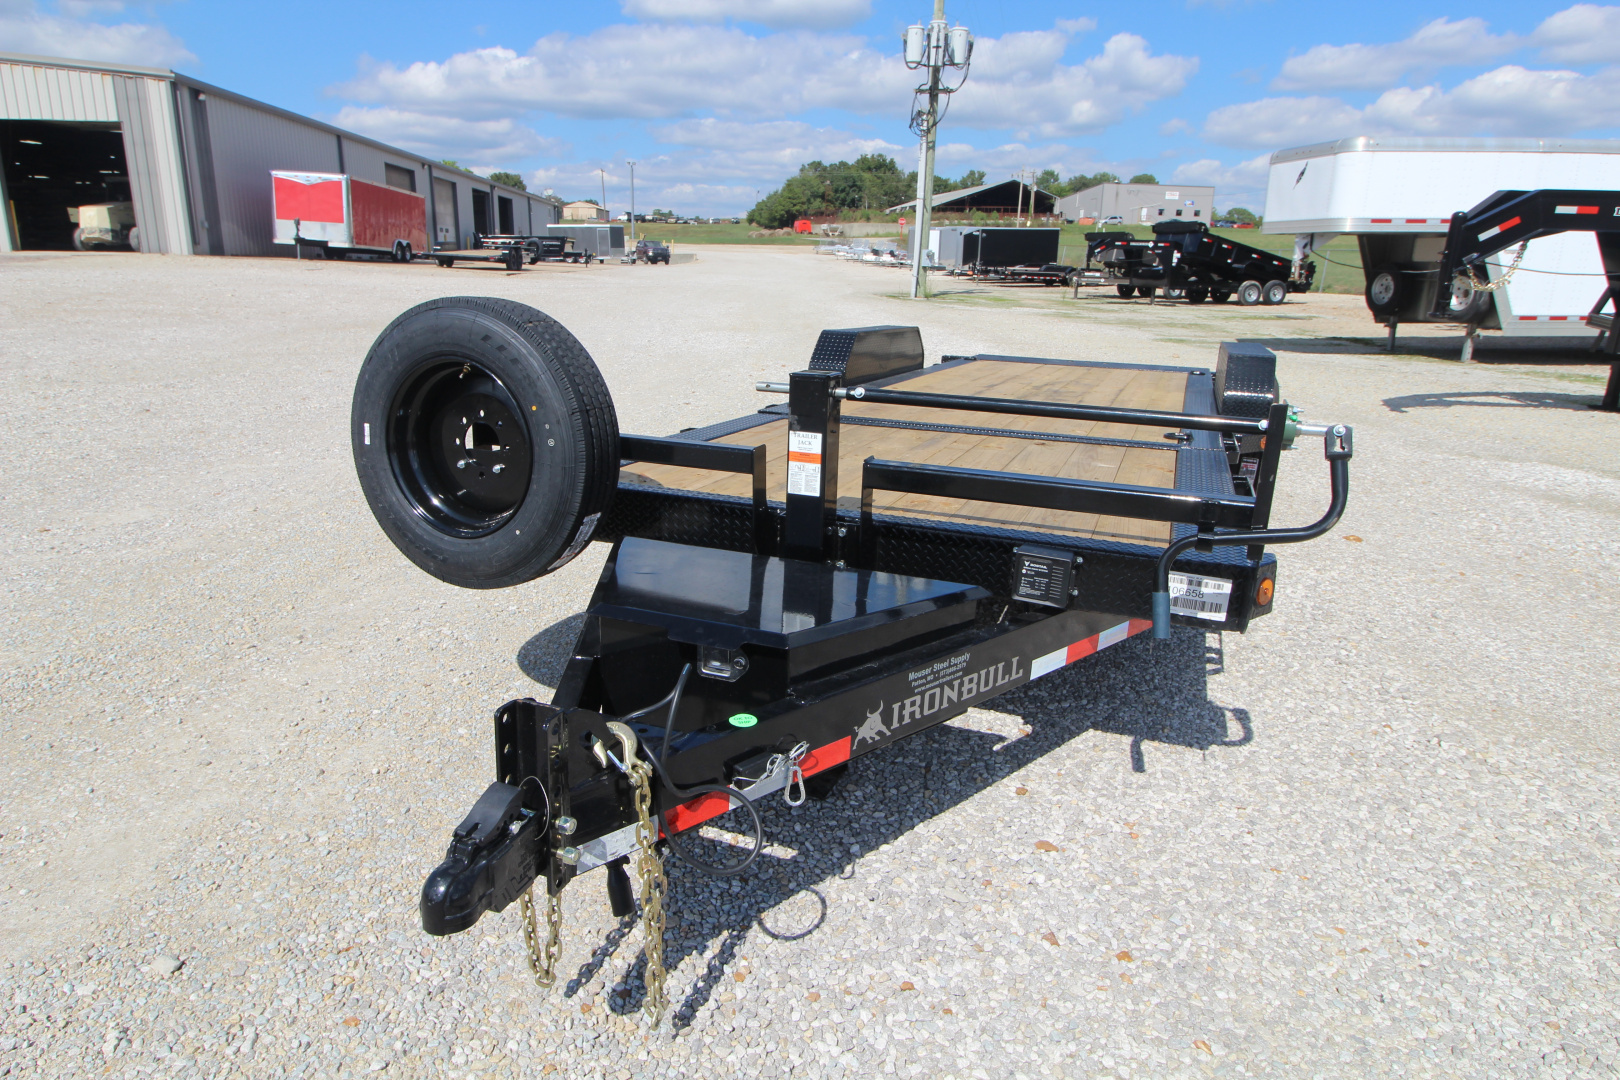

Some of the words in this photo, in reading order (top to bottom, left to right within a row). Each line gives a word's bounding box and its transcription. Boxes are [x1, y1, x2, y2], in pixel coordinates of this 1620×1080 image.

[794, 432, 818, 440] TRAILER
[908, 666, 933, 682] Mouser
[932, 658, 950, 672] Steel
[950, 651, 971, 665] Supply
[890, 655, 1024, 730] IRONBULL
